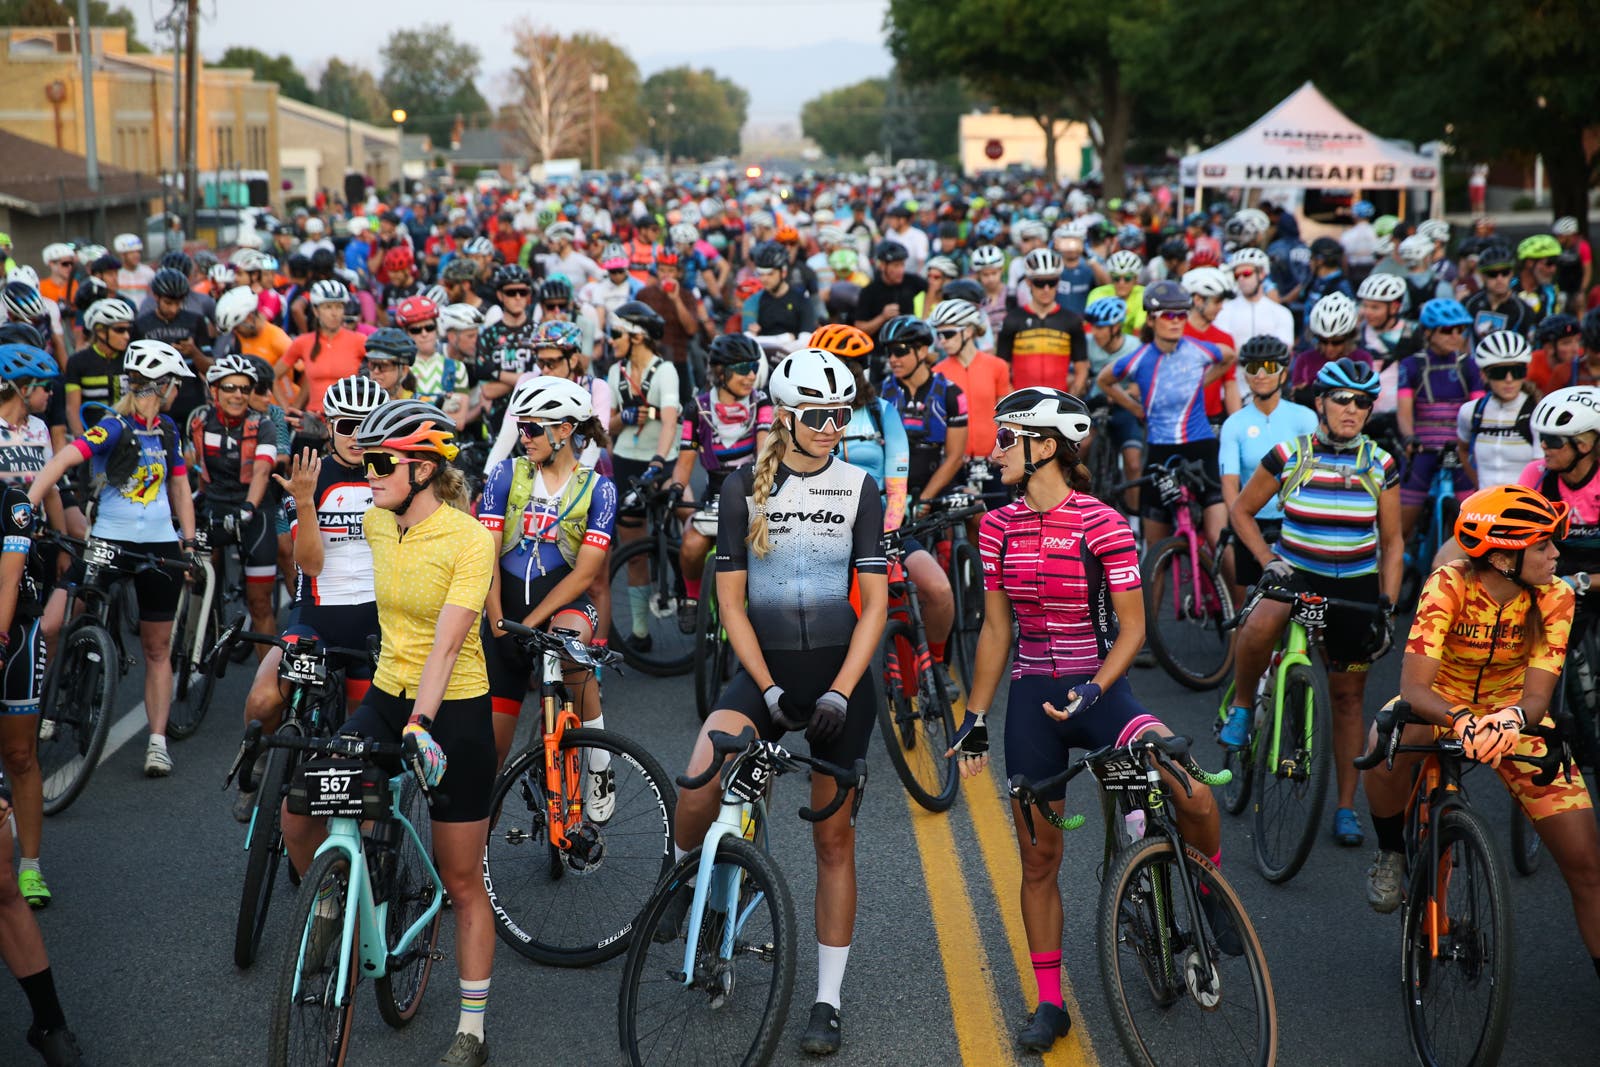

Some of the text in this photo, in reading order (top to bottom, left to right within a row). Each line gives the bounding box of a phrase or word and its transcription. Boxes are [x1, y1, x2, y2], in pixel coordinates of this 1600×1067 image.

[1245, 165, 1364, 181] HANGAR
[808, 488, 853, 497] SHIMANO
[949, 497, 969, 507] 724
[1466, 512, 1497, 523] KASK
[586, 535, 608, 546] CLIF
[1043, 536, 1076, 547] DNA
[1484, 535, 1528, 547] CANYON
[94, 546, 115, 560] 320
[1098, 572, 1108, 633] nnondale
[1300, 607, 1324, 620] 203
[293, 659, 316, 674] 621
[1104, 760, 1132, 771] 515
[320, 776, 351, 793] 567
